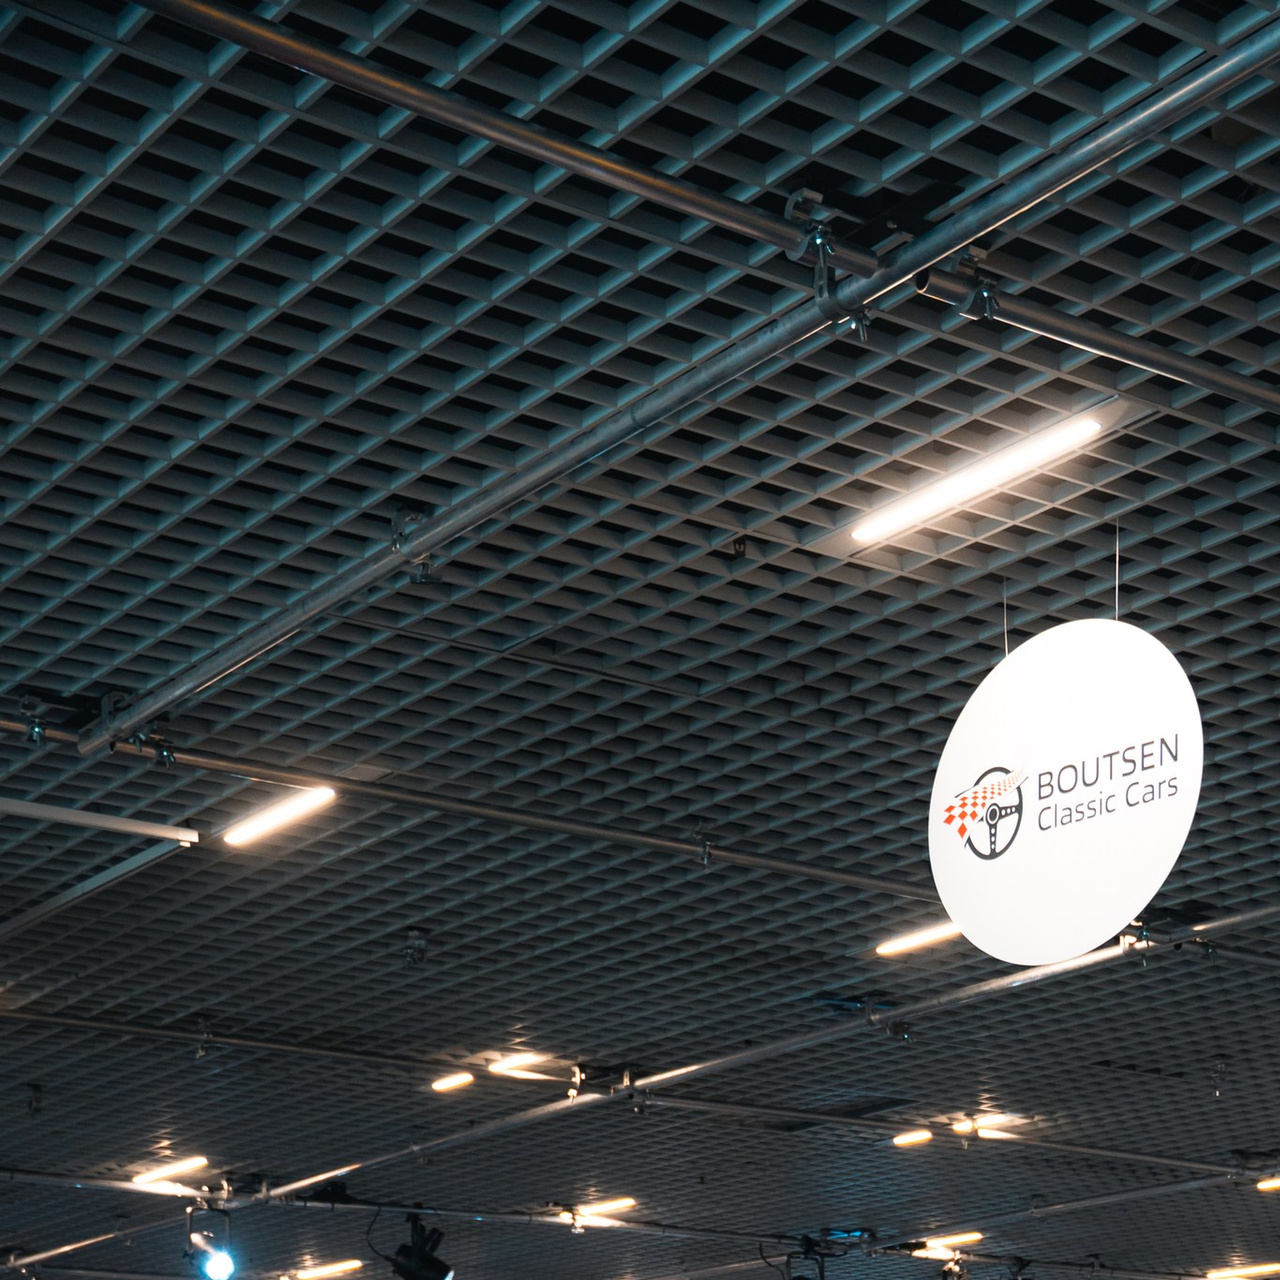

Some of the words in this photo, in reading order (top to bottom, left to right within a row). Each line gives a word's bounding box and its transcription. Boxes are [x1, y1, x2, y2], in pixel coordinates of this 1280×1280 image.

[1038, 733, 1179, 801] BOUTSEN
[1038, 791, 1116, 832] Classic
[1125, 776, 1179, 808] Cars
